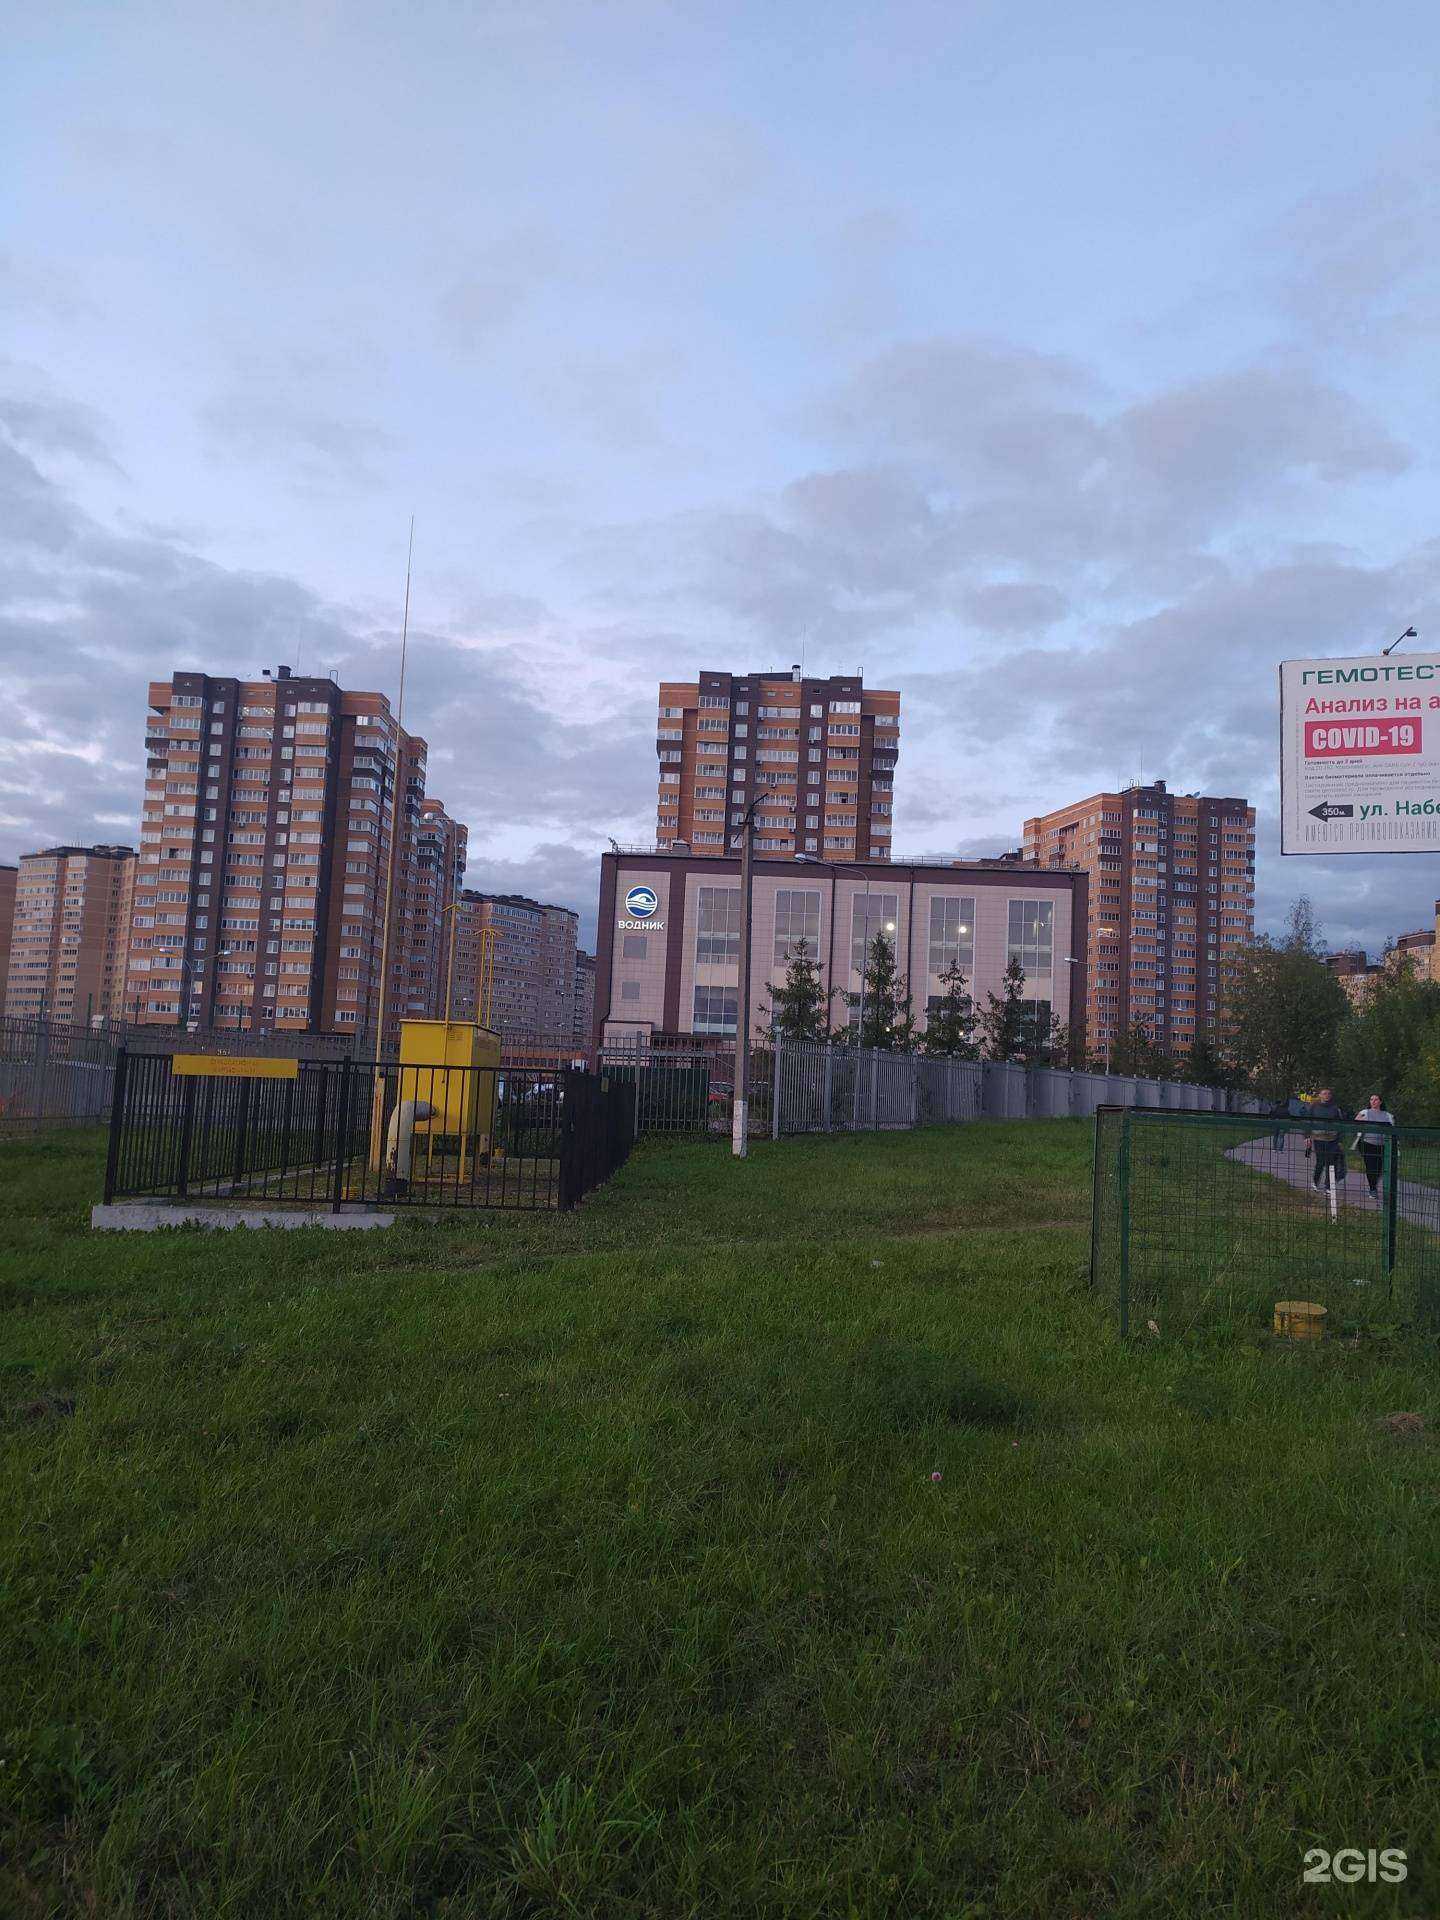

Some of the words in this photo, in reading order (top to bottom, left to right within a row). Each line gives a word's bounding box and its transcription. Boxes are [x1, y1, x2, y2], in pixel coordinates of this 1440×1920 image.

[1305, 698, 1388, 714] Анализ
[1395, 697, 1421, 711] на
[1312, 725, 1414, 750] COVID-19
[1360, 804, 1389, 820] ул.
[618, 920, 665, 930] ВОДНИК
